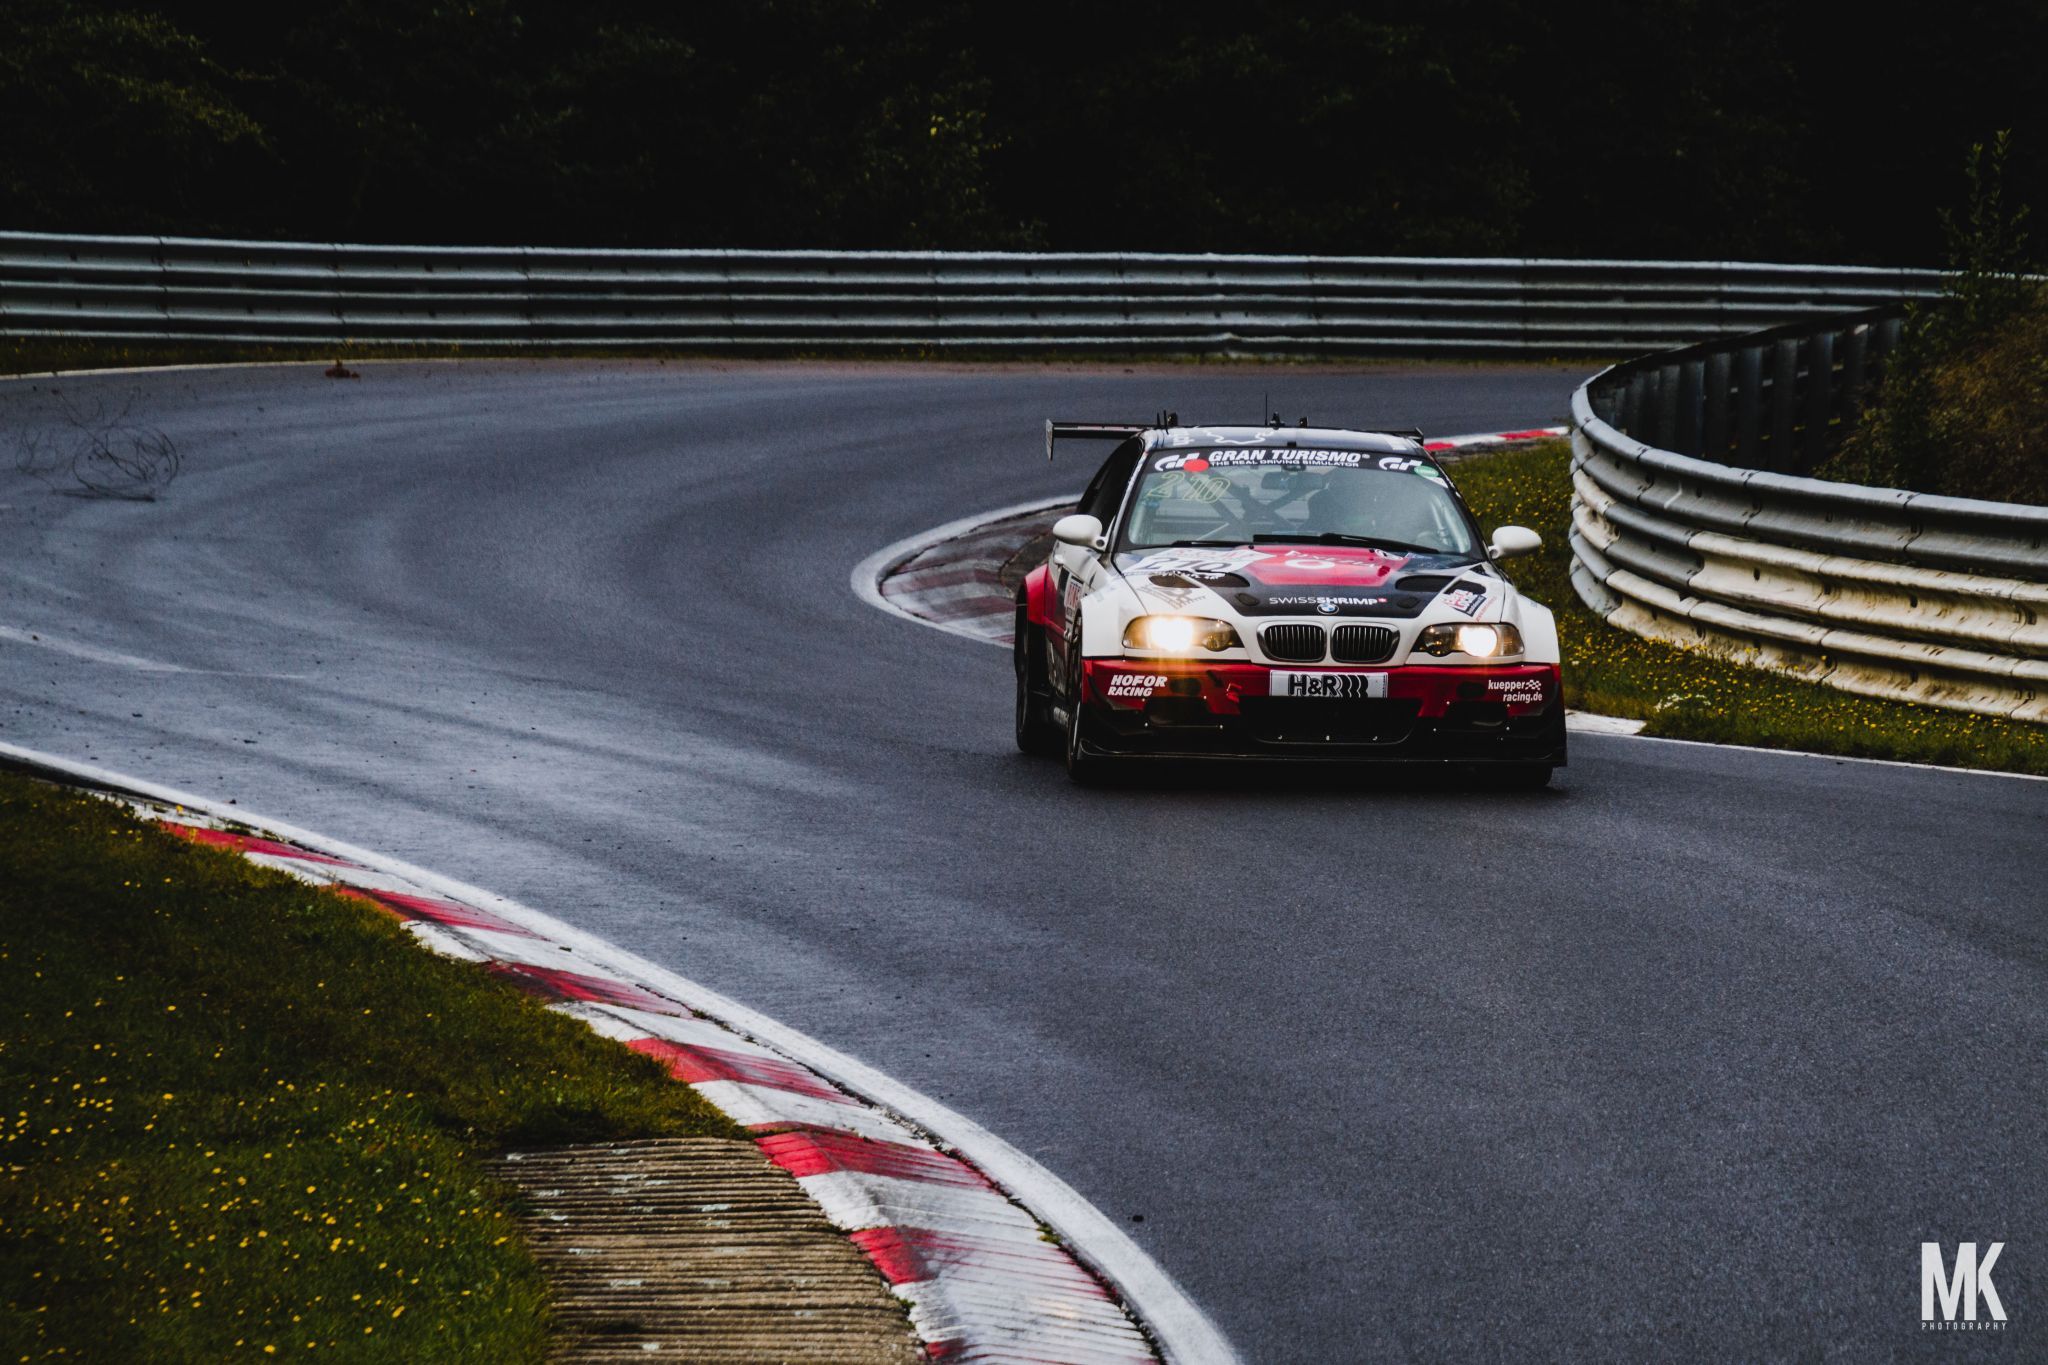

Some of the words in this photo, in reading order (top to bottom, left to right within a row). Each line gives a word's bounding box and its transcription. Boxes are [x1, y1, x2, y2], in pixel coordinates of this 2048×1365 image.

[1208, 449, 1267, 462] GRAN
[1302, 460, 1360, 468] SIMULATOR
[1110, 674, 1168, 688] HOFOR
[1287, 673, 1344, 698] H&R
[1488, 679, 1526, 692] kuepper
[1107, 686, 1153, 697] RACING
[1503, 691, 1543, 704] racing.de
